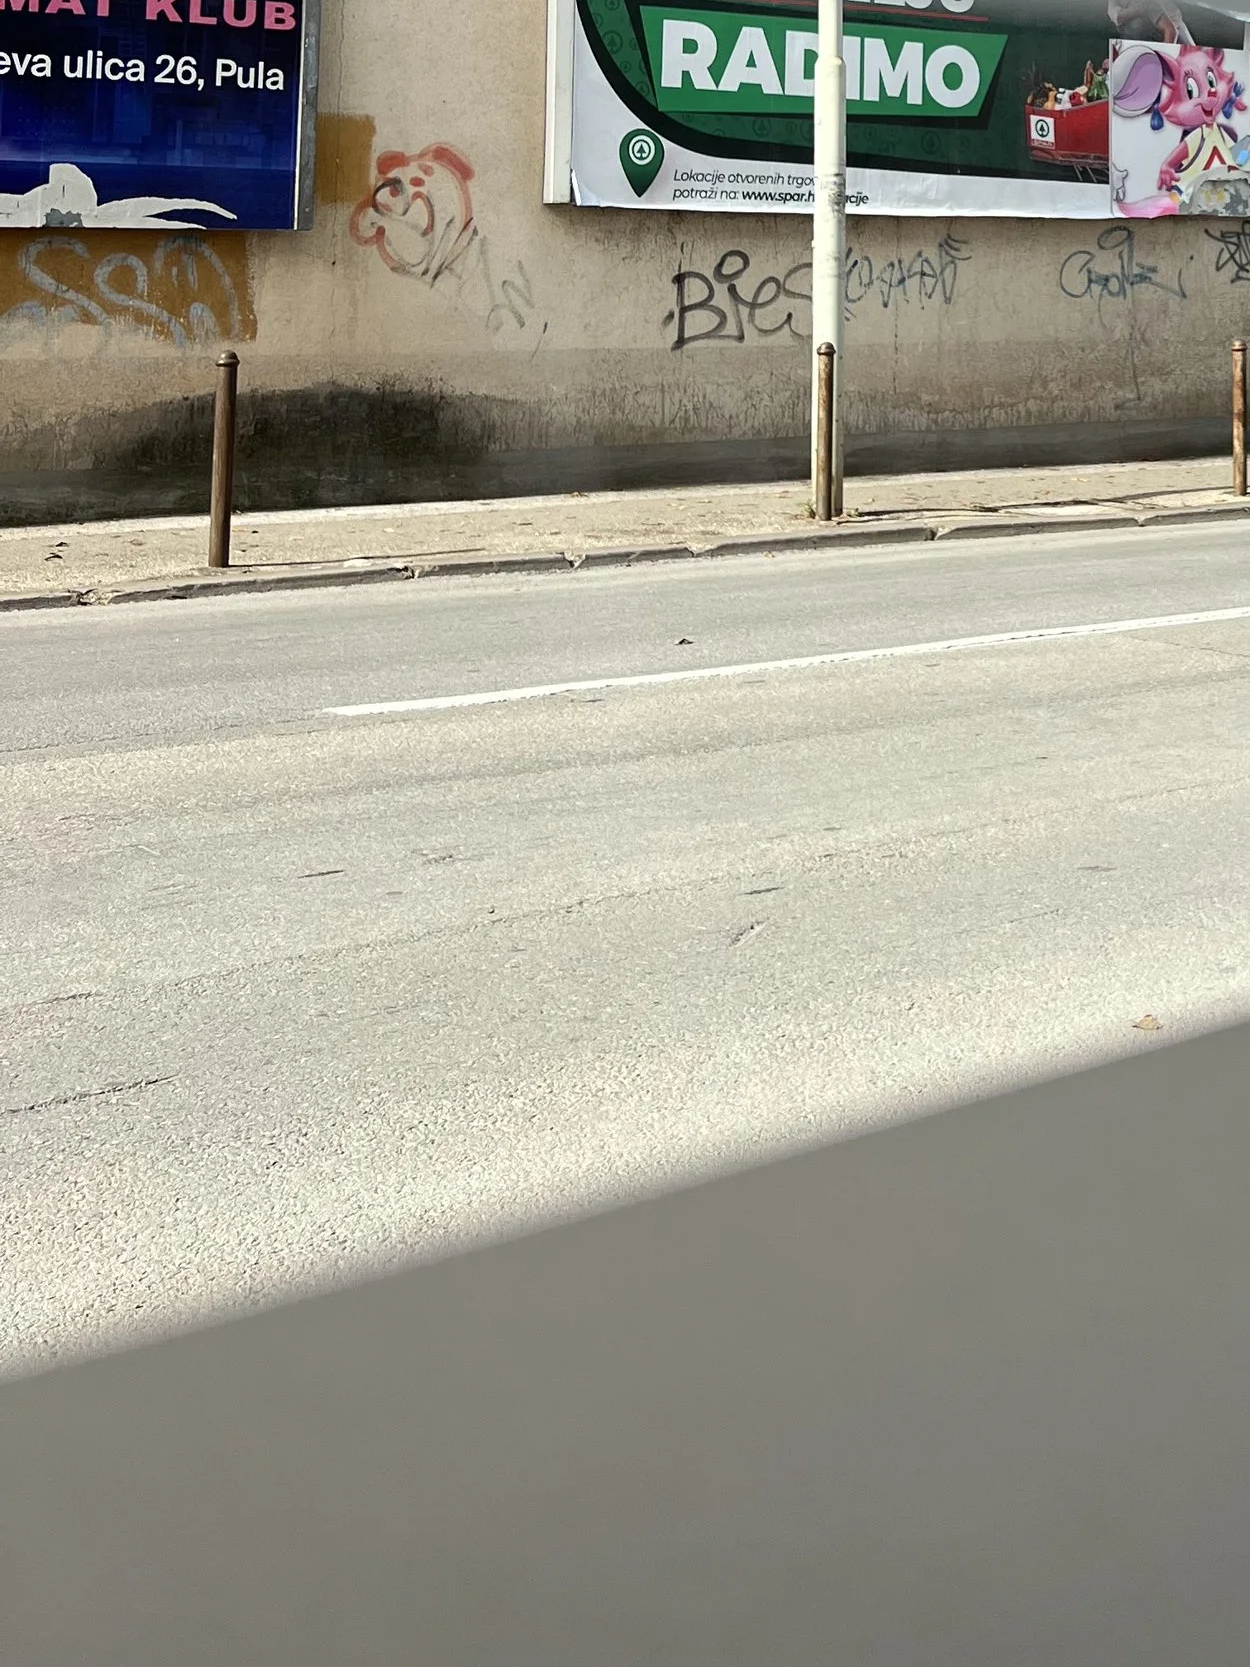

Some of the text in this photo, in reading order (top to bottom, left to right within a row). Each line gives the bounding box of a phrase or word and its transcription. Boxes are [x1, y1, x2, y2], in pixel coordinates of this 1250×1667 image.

[63, 49, 145, 82] ulica
[153, 53, 205, 92] 26,
[215, 58, 284, 91] Pula
[661, 18, 980, 109] RADIMO
[673, 168, 726, 185] Lokacije
[727, 173, 785, 187] otvorenih
[672, 185, 718, 202] potraži
[720, 190, 740, 201] na:
